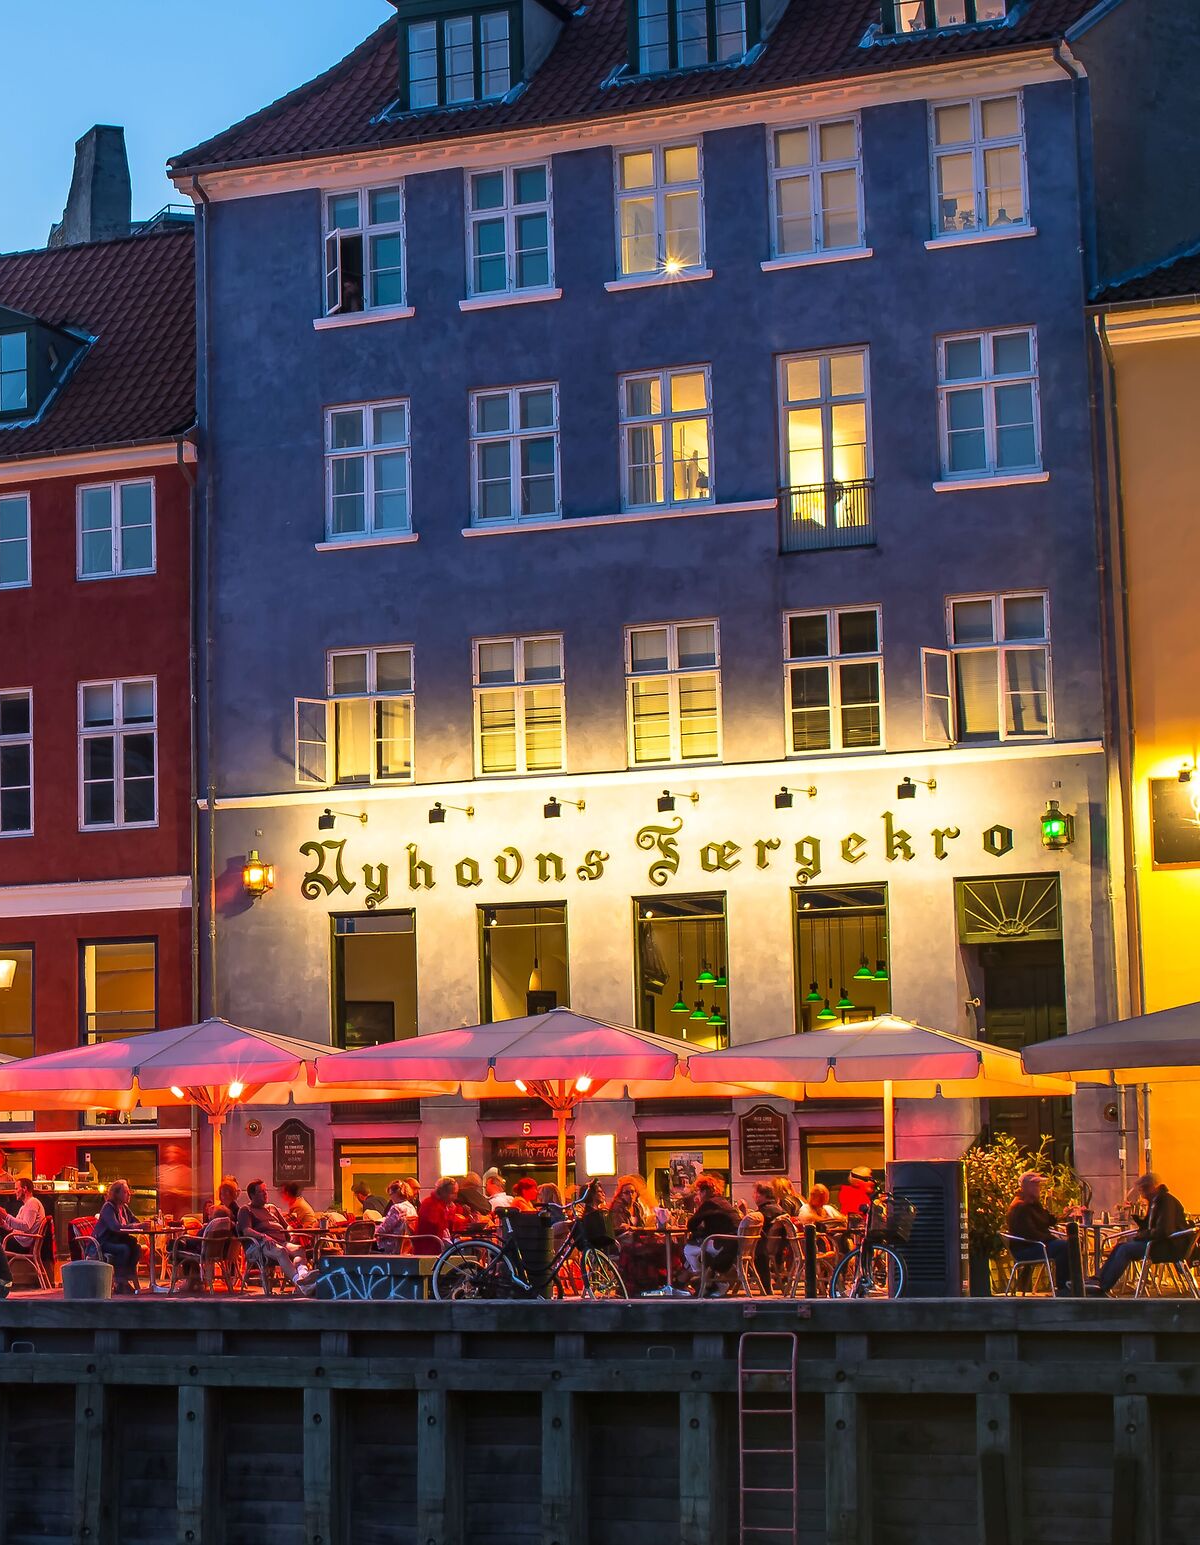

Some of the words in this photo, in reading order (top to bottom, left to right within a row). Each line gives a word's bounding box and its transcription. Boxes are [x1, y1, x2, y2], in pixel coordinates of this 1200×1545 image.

[299, 839, 611, 909] Nyhavns
[636, 811, 1014, 886] Færgekro
[522, 1122, 531, 1134] 5
